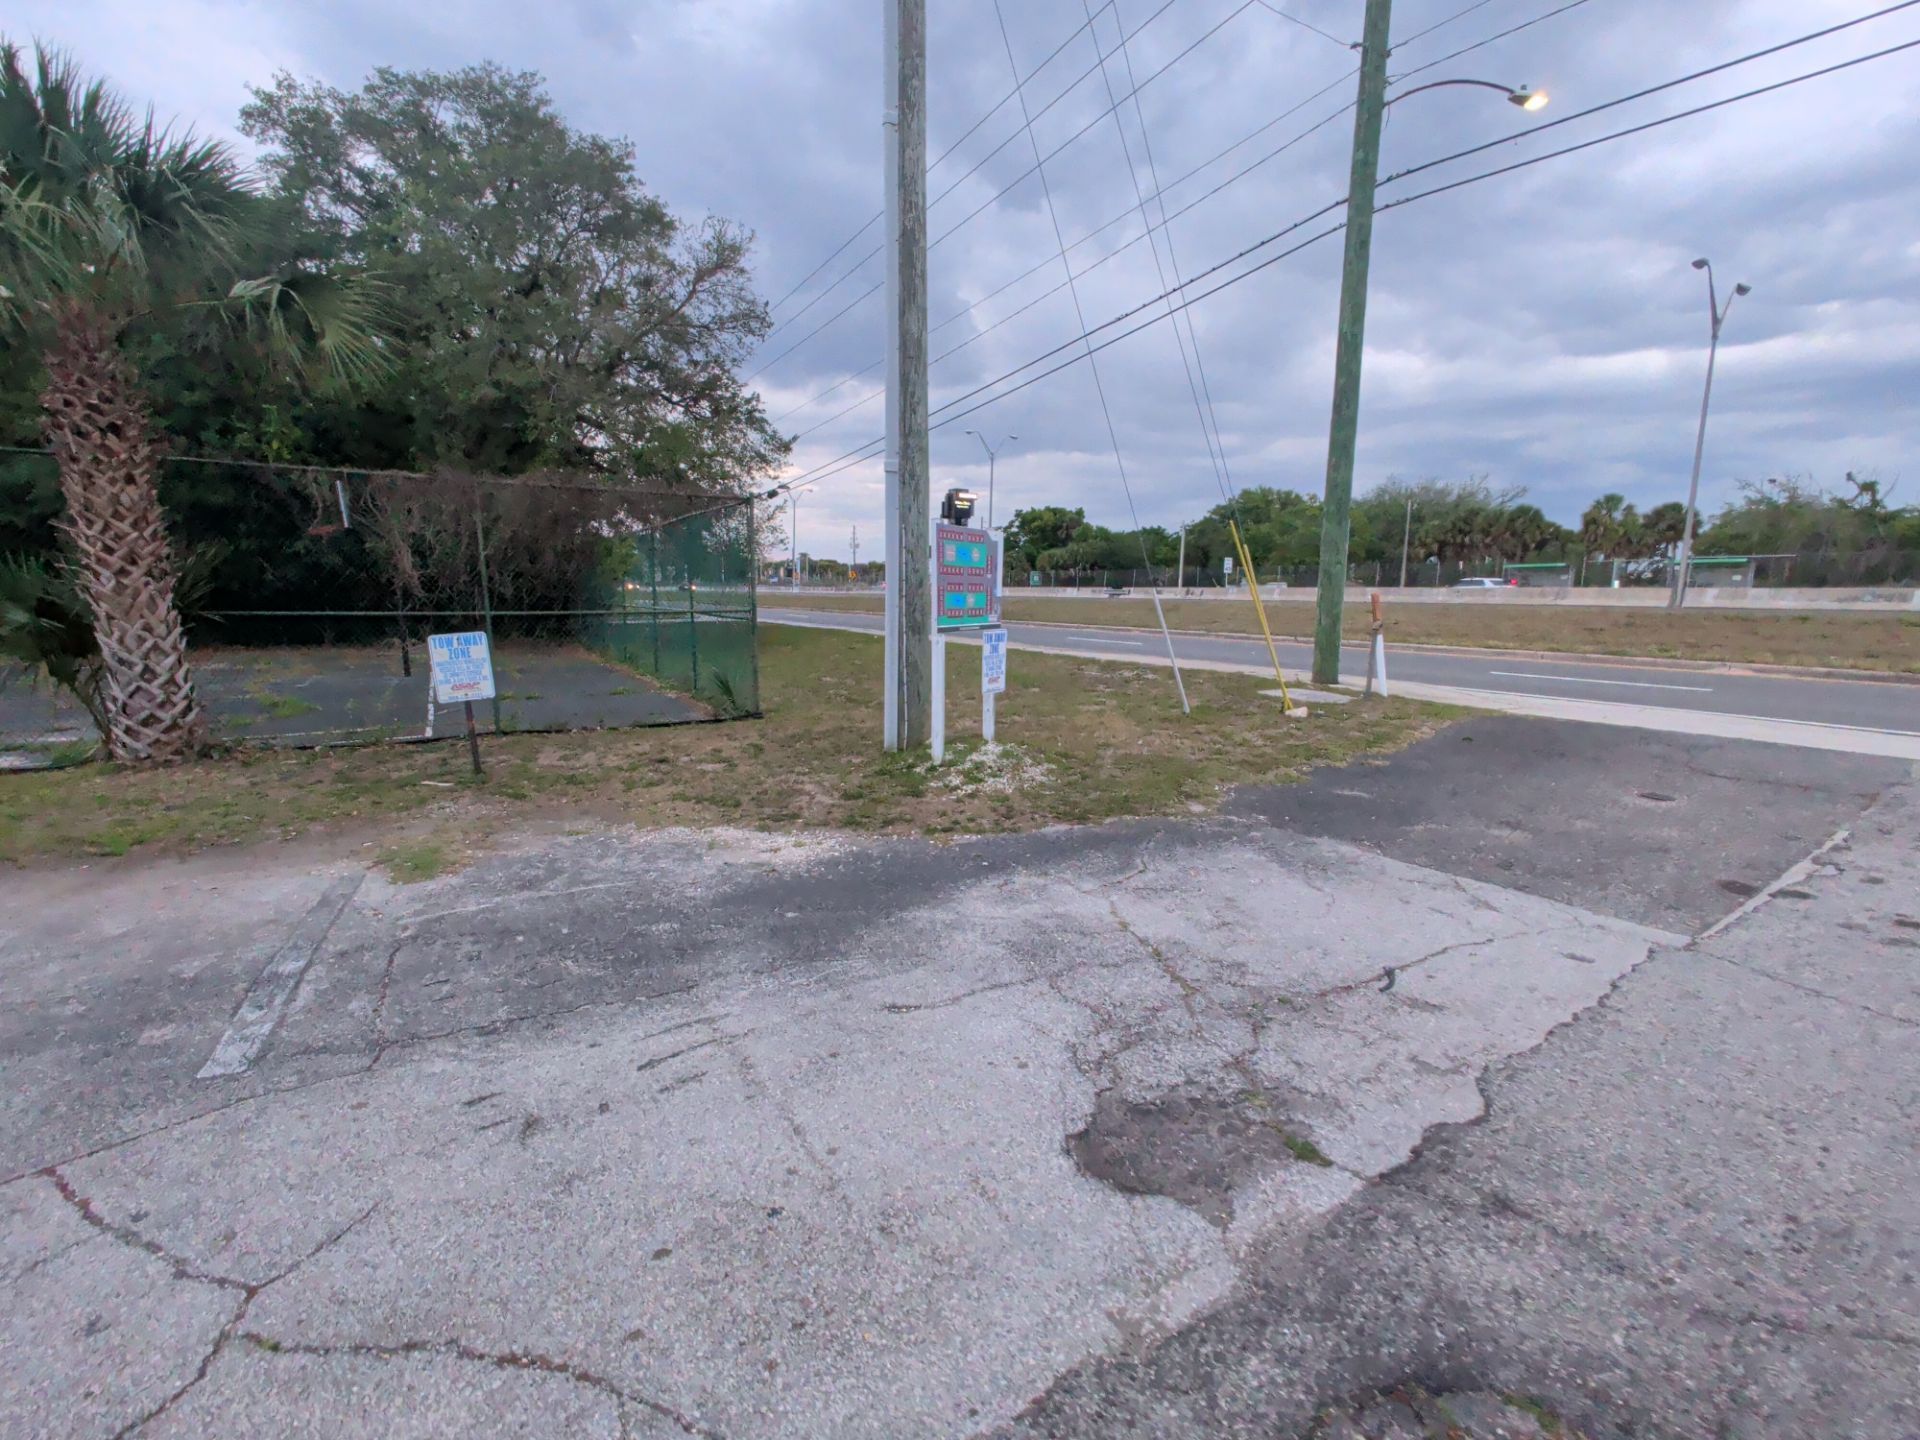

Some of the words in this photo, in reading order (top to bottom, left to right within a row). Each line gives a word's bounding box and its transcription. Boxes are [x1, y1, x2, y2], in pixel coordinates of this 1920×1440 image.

[431, 636, 453, 649] TOW
[456, 633, 483, 646] AWAY
[447, 647, 471, 660] ZONE
